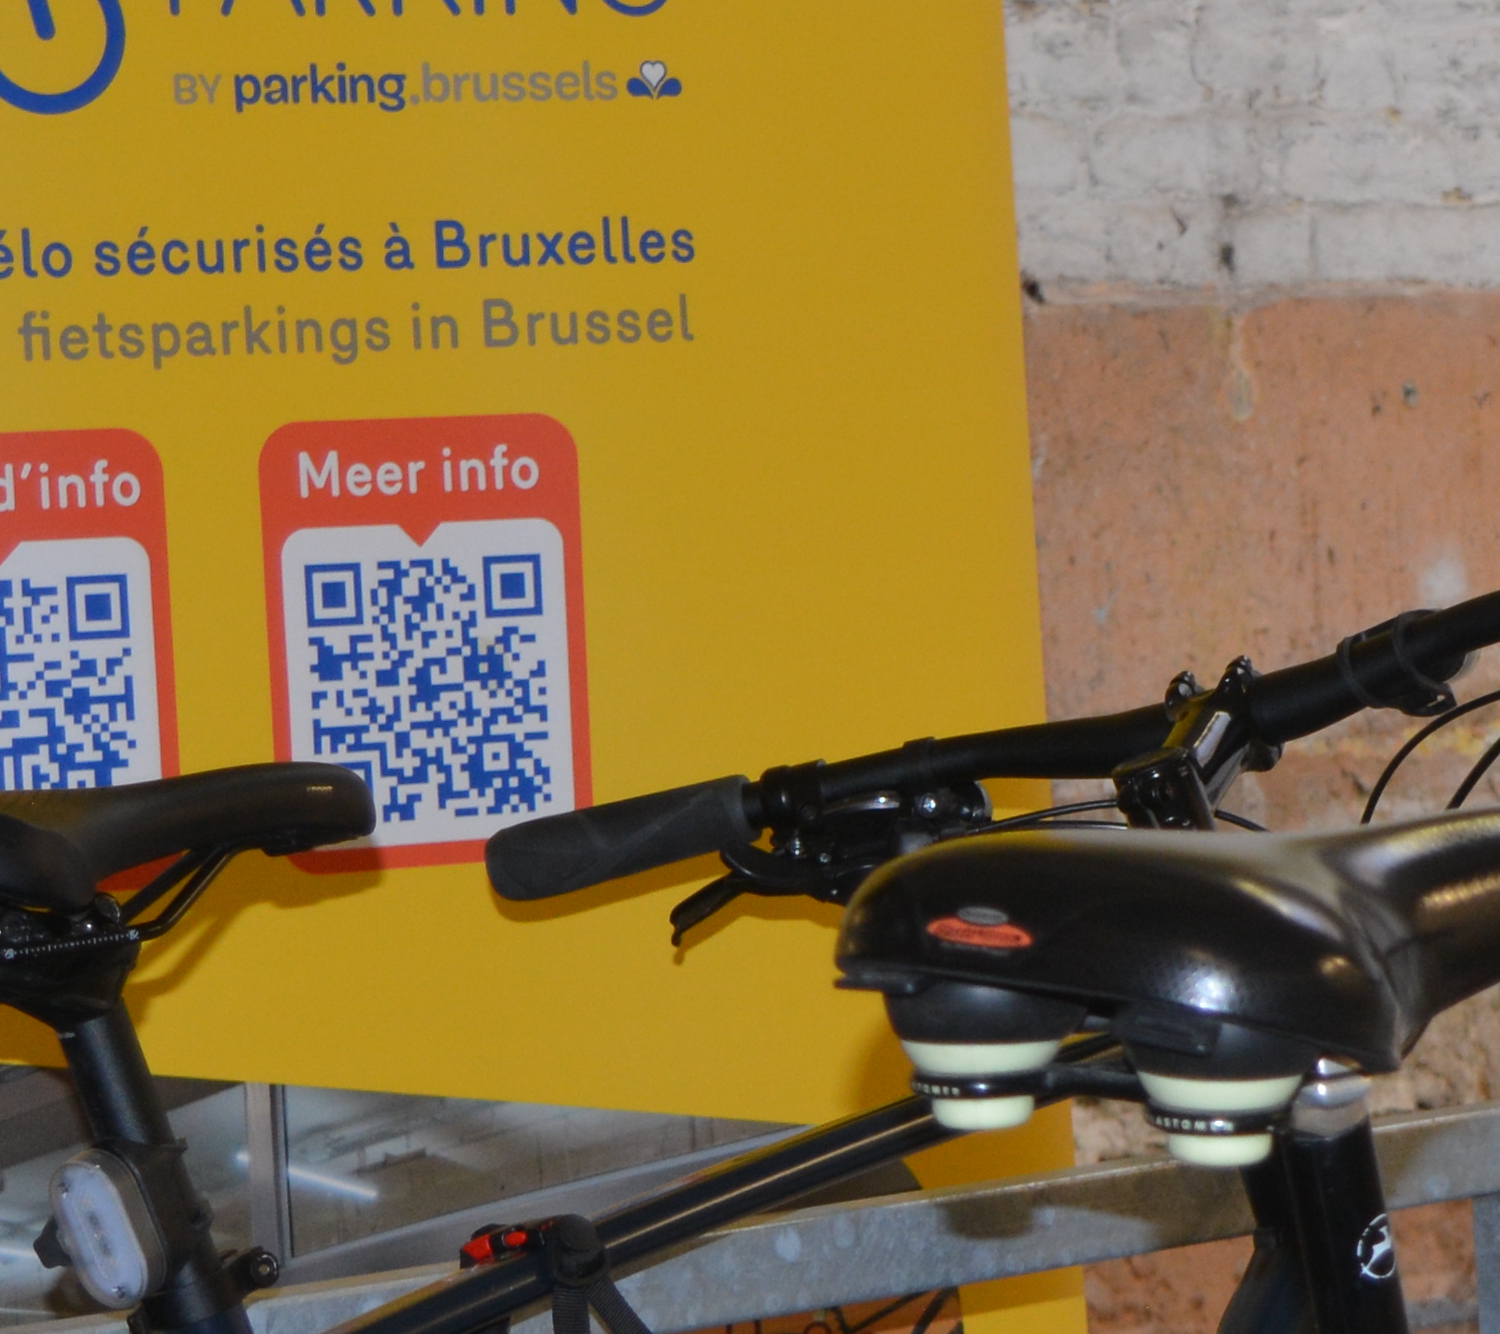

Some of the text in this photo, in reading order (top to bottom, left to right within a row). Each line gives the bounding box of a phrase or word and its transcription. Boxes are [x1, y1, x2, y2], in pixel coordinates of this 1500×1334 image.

[173, 62, 618, 113] BY parking.brussels
[94, 224, 364, 277] sécurisés
[385, 223, 415, 270] à
[434, 217, 695, 269] Bruxelles
[17, 306, 390, 370] fietsparkings
[412, 302, 459, 350] in
[482, 294, 694, 348] Brussel
[298, 444, 539, 498] Meer info
